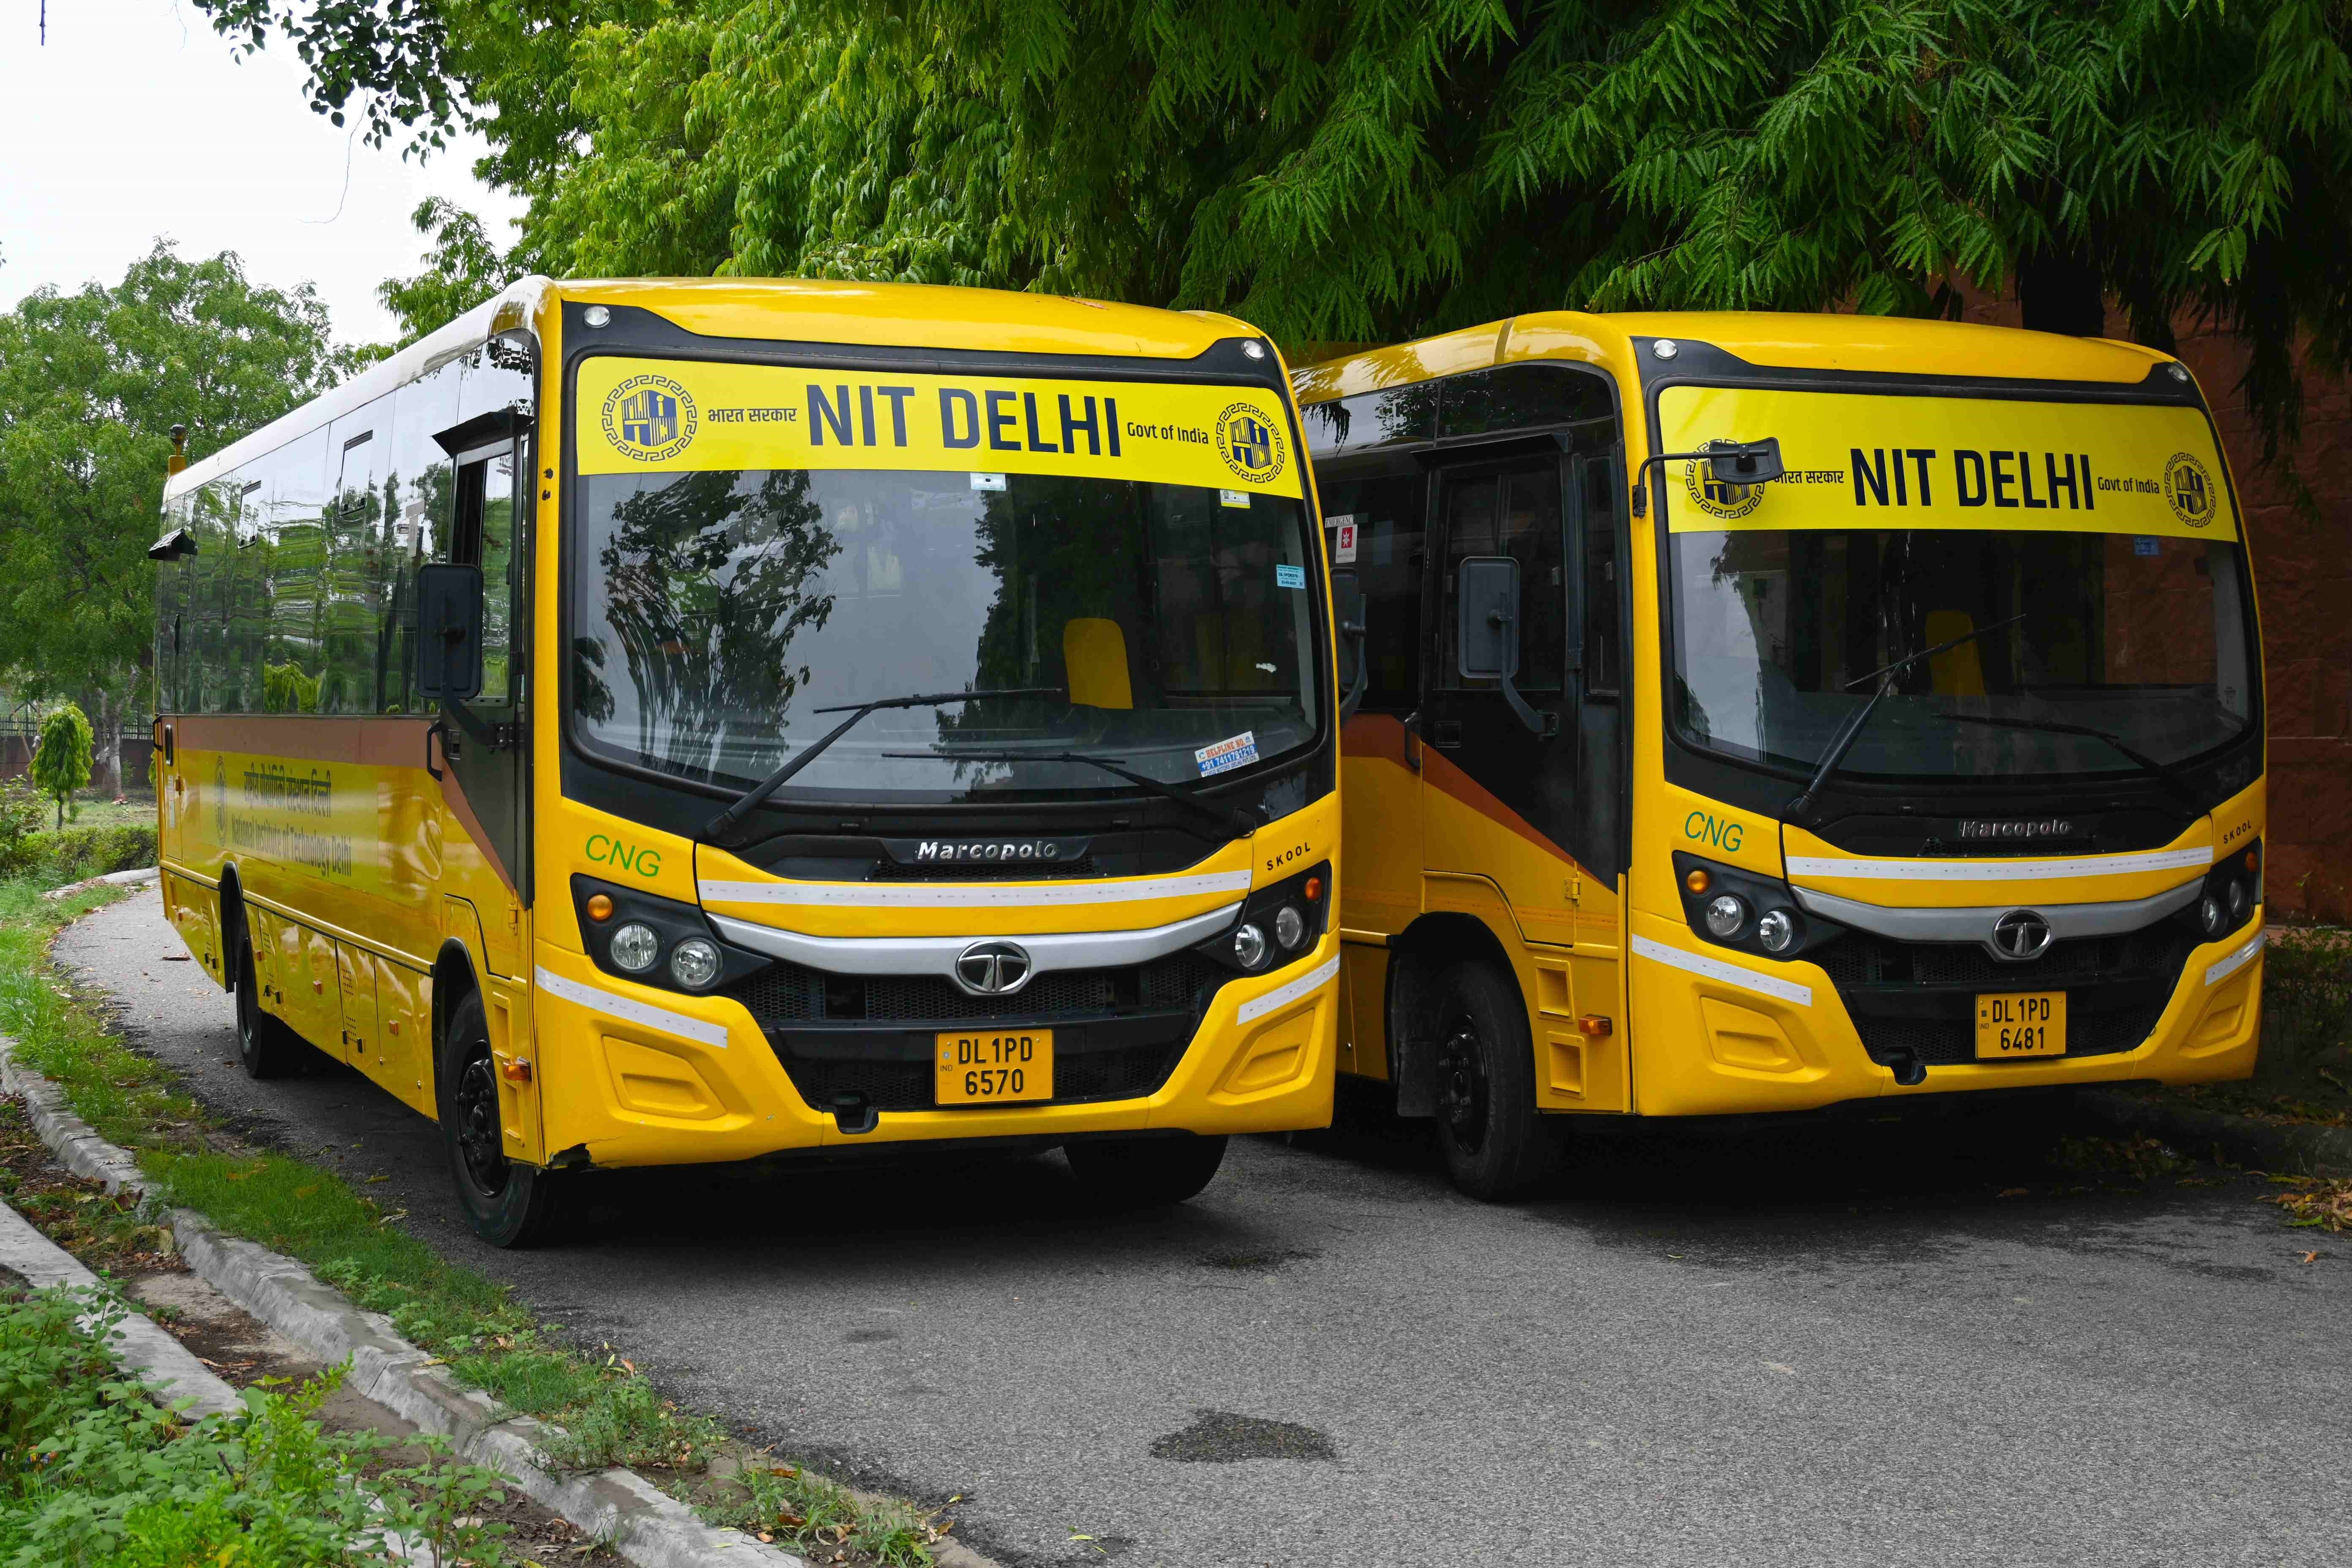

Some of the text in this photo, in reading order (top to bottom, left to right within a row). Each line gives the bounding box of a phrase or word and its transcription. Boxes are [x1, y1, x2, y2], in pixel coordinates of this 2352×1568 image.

[708, 408, 798, 422] भारत सरकार
[806, 384, 1121, 457] NIT DELHI
[1127, 422, 1209, 444] Govt of India
[1805, 471, 1844, 484] सरकार
[1850, 448, 2094, 510] NIT DELHI
[2098, 477, 2160, 494] Govt of India
[1202, 745, 1255, 770] +91 7411781219
[1205, 738, 1245, 758] HELPLINE NO.
[1685, 811, 1744, 852] CNG
[1960, 819, 2069, 838] Marcopolo
[2223, 819, 2251, 844] SKOOL
[232, 813, 351, 878] National Institute of Technology Delhi
[585, 834, 662, 877] CNG
[917, 841, 1057, 860] Marcopolo
[1266, 842, 1311, 871] SKOOL
[2001, 1026, 2044, 1051] 6481
[965, 1068, 1024, 1096] 6570
